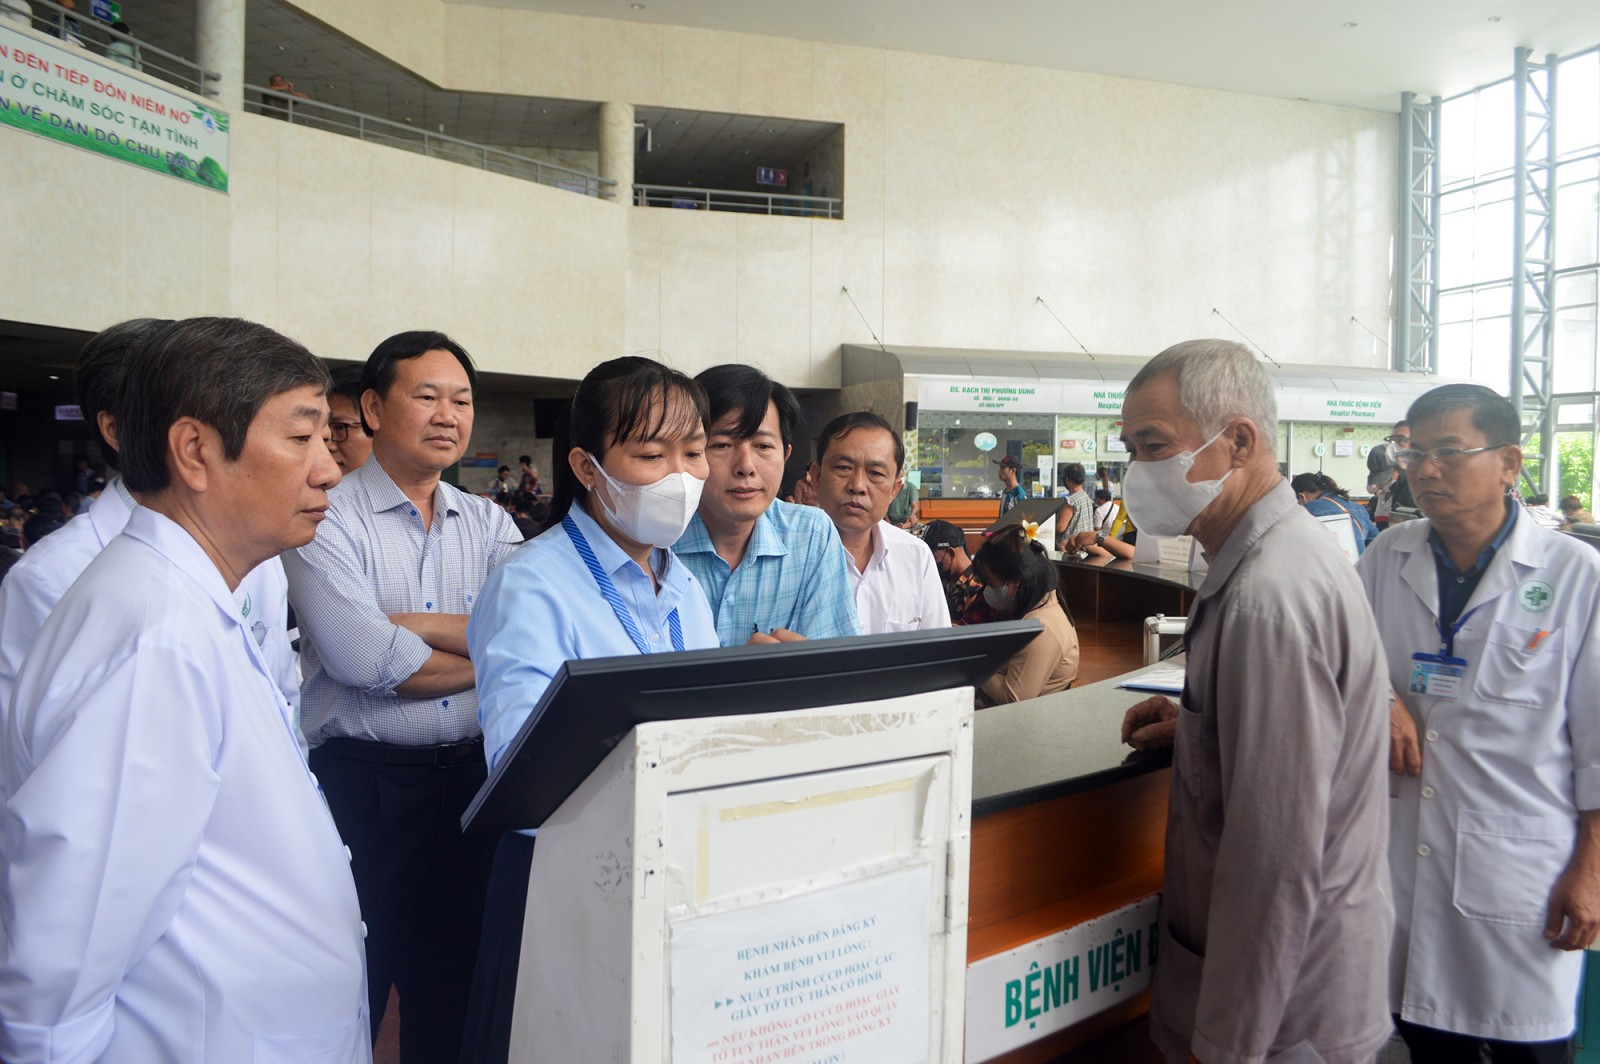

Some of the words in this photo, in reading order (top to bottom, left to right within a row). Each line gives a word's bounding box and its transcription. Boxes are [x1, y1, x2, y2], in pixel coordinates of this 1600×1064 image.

[13, 48, 49, 74] ĐẾN
[54, 63, 89, 87] TIẾP
[93, 79, 127, 102] ĐÓN
[17, 101, 43, 122] VỀ
[94, 127, 120, 147] DÒ
[125, 139, 161, 159] CHU
[32, 81, 85, 111] CHĂM
[90, 102, 125, 124] SÓC
[129, 115, 161, 137] TẬN
[165, 127, 199, 150] TÌNH
[962, 386, 979, 395] BẠCH
[992, 387, 1017, 395] PHƯƠNG
[1018, 387, 1035, 395] DUNG
[1093, 391, 1106, 399] NHÀ
[1326, 399, 1338, 407] NHÀ
[1338, 399, 1355, 408] THUỐC
[1355, 399, 1369, 409] BỆNH
[1370, 400, 1382, 409] VIỆN
[1329, 409, 1350, 417] Hospital
[1351, 410, 1376, 418] Pharmacy
[1086, 440, 1093, 450] 2
[1317, 445, 1323, 453] 6
[737, 943, 769, 961] BỆNH
[773, 935, 805, 951] NHÂN
[807, 927, 830, 945] ĐẾN
[832, 920, 861, 938] ĐĂNG
[863, 914, 878, 928] KÝ
[739, 986, 771, 1005] XUẤT
[775, 977, 811, 996] TRÌNH
[813, 968, 843, 986] CCCD
[844, 958, 874, 976] HOẶC
[875, 951, 897, 966] CÁC
[744, 963, 780, 981] KHÁM
[783, 956, 814, 972] BỆNH
[817, 949, 836, 962] VUI
[1005, 955, 1080, 1030] BỆNH
[1087, 927, 1142, 993] VIỆN
[731, 1005, 760, 1021] GIẤY
[764, 998, 780, 1013] TỜ
[809, 983, 838, 1001] THÂN
[839, 978, 855, 992] CÓ
[857, 970, 883, 986] HÌNH
[750, 1017, 793, 1038] KHÔNG
[795, 1011, 812, 1026] CÓ
[813, 1003, 843, 1020] CCCD
[793, 1026, 812, 1040] VUI
[847, 1009, 869, 1024] VÀO
[809, 1032, 845, 1051] TRONG
